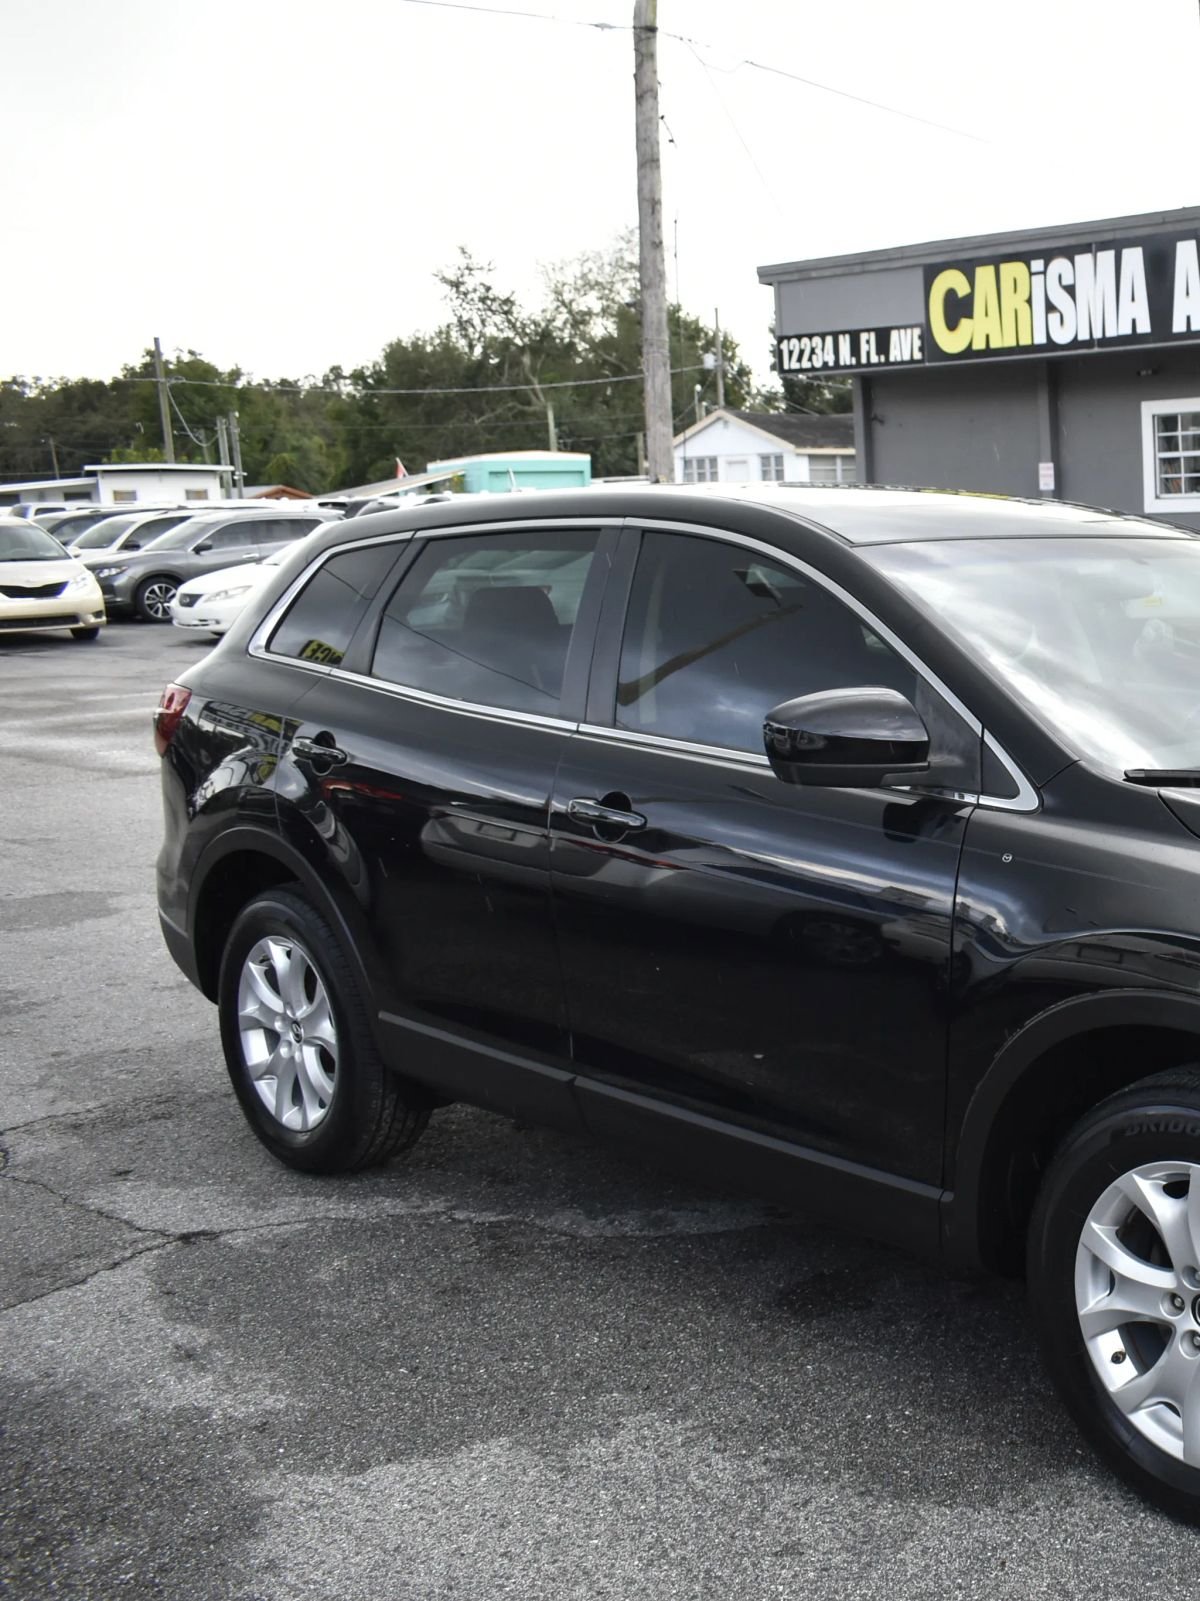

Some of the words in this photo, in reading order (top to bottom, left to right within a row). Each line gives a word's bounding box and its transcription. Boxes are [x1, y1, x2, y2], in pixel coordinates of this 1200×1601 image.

[929, 247, 1151, 355] CARiSMA
[780, 337, 835, 370] 12234
[838, 333, 856, 366] N.
[859, 331, 885, 364] FL.
[889, 327, 922, 362] AVE
